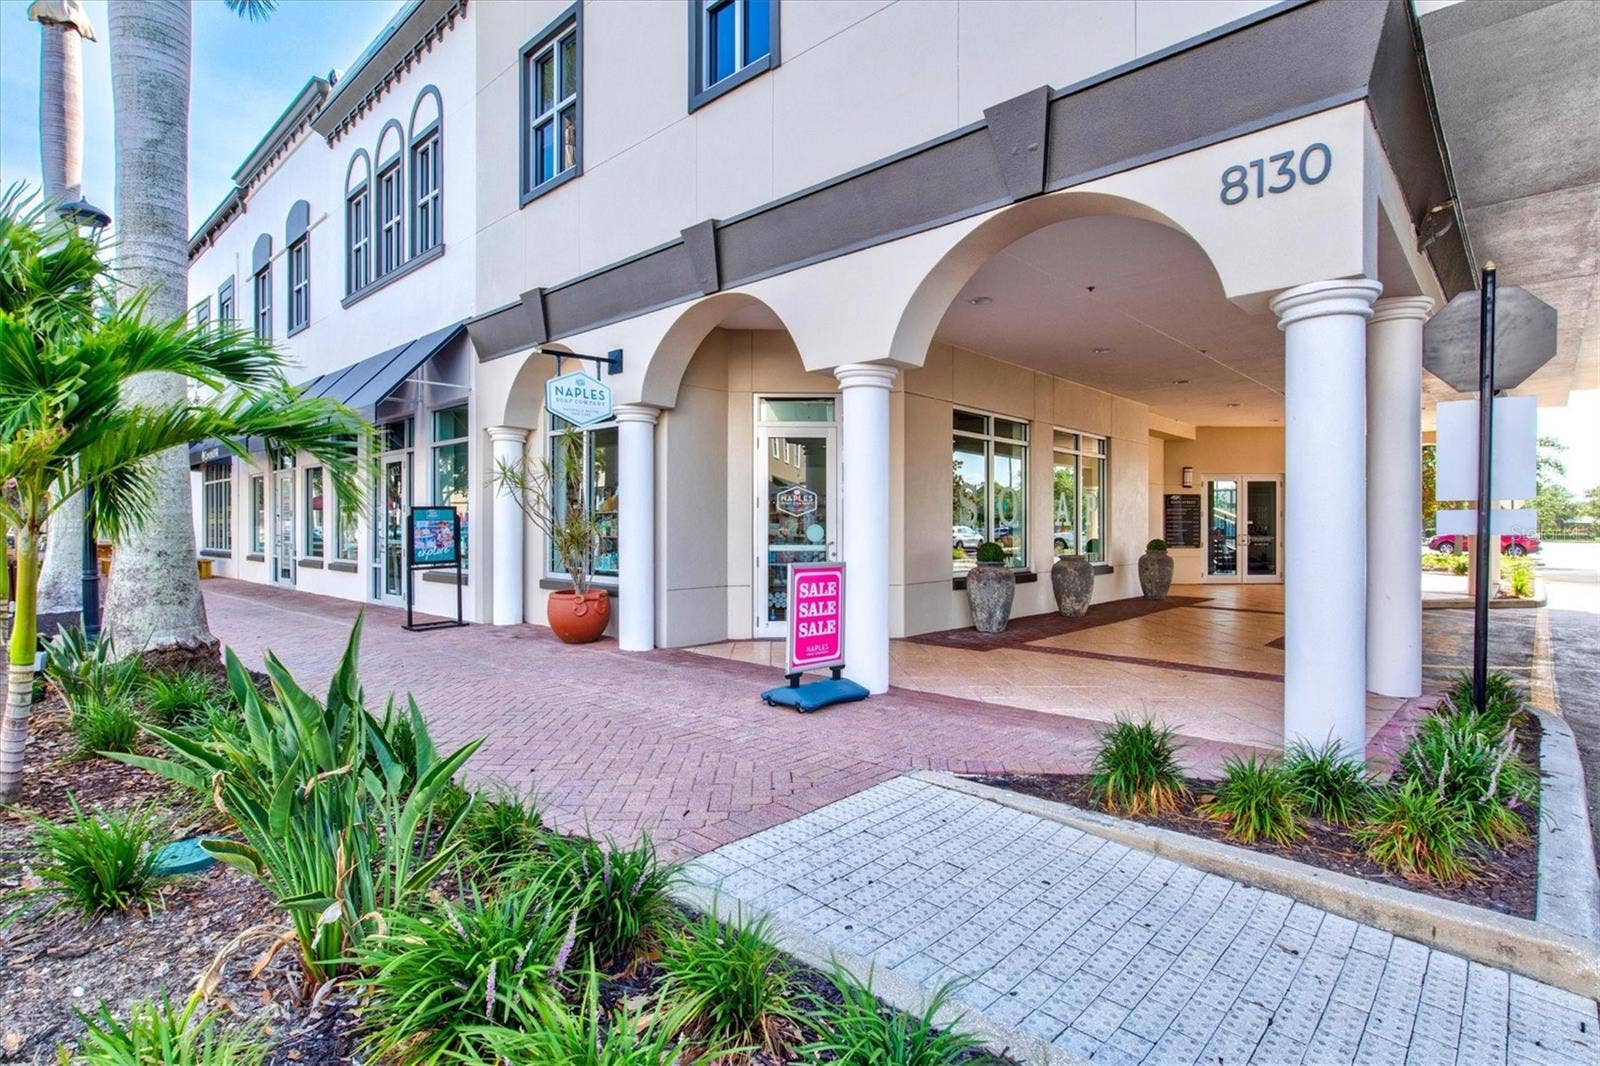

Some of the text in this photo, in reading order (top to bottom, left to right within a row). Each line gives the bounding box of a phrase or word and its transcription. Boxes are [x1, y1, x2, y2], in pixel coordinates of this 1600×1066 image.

[1220, 142, 1332, 206] 8130
[555, 386, 605, 400] NAPLES
[780, 494, 813, 502] NAPLES
[799, 581, 837, 599] SALE
[799, 600, 837, 618] SALE
[799, 620, 836, 638] SALE
[806, 643, 829, 652] NAPLES
